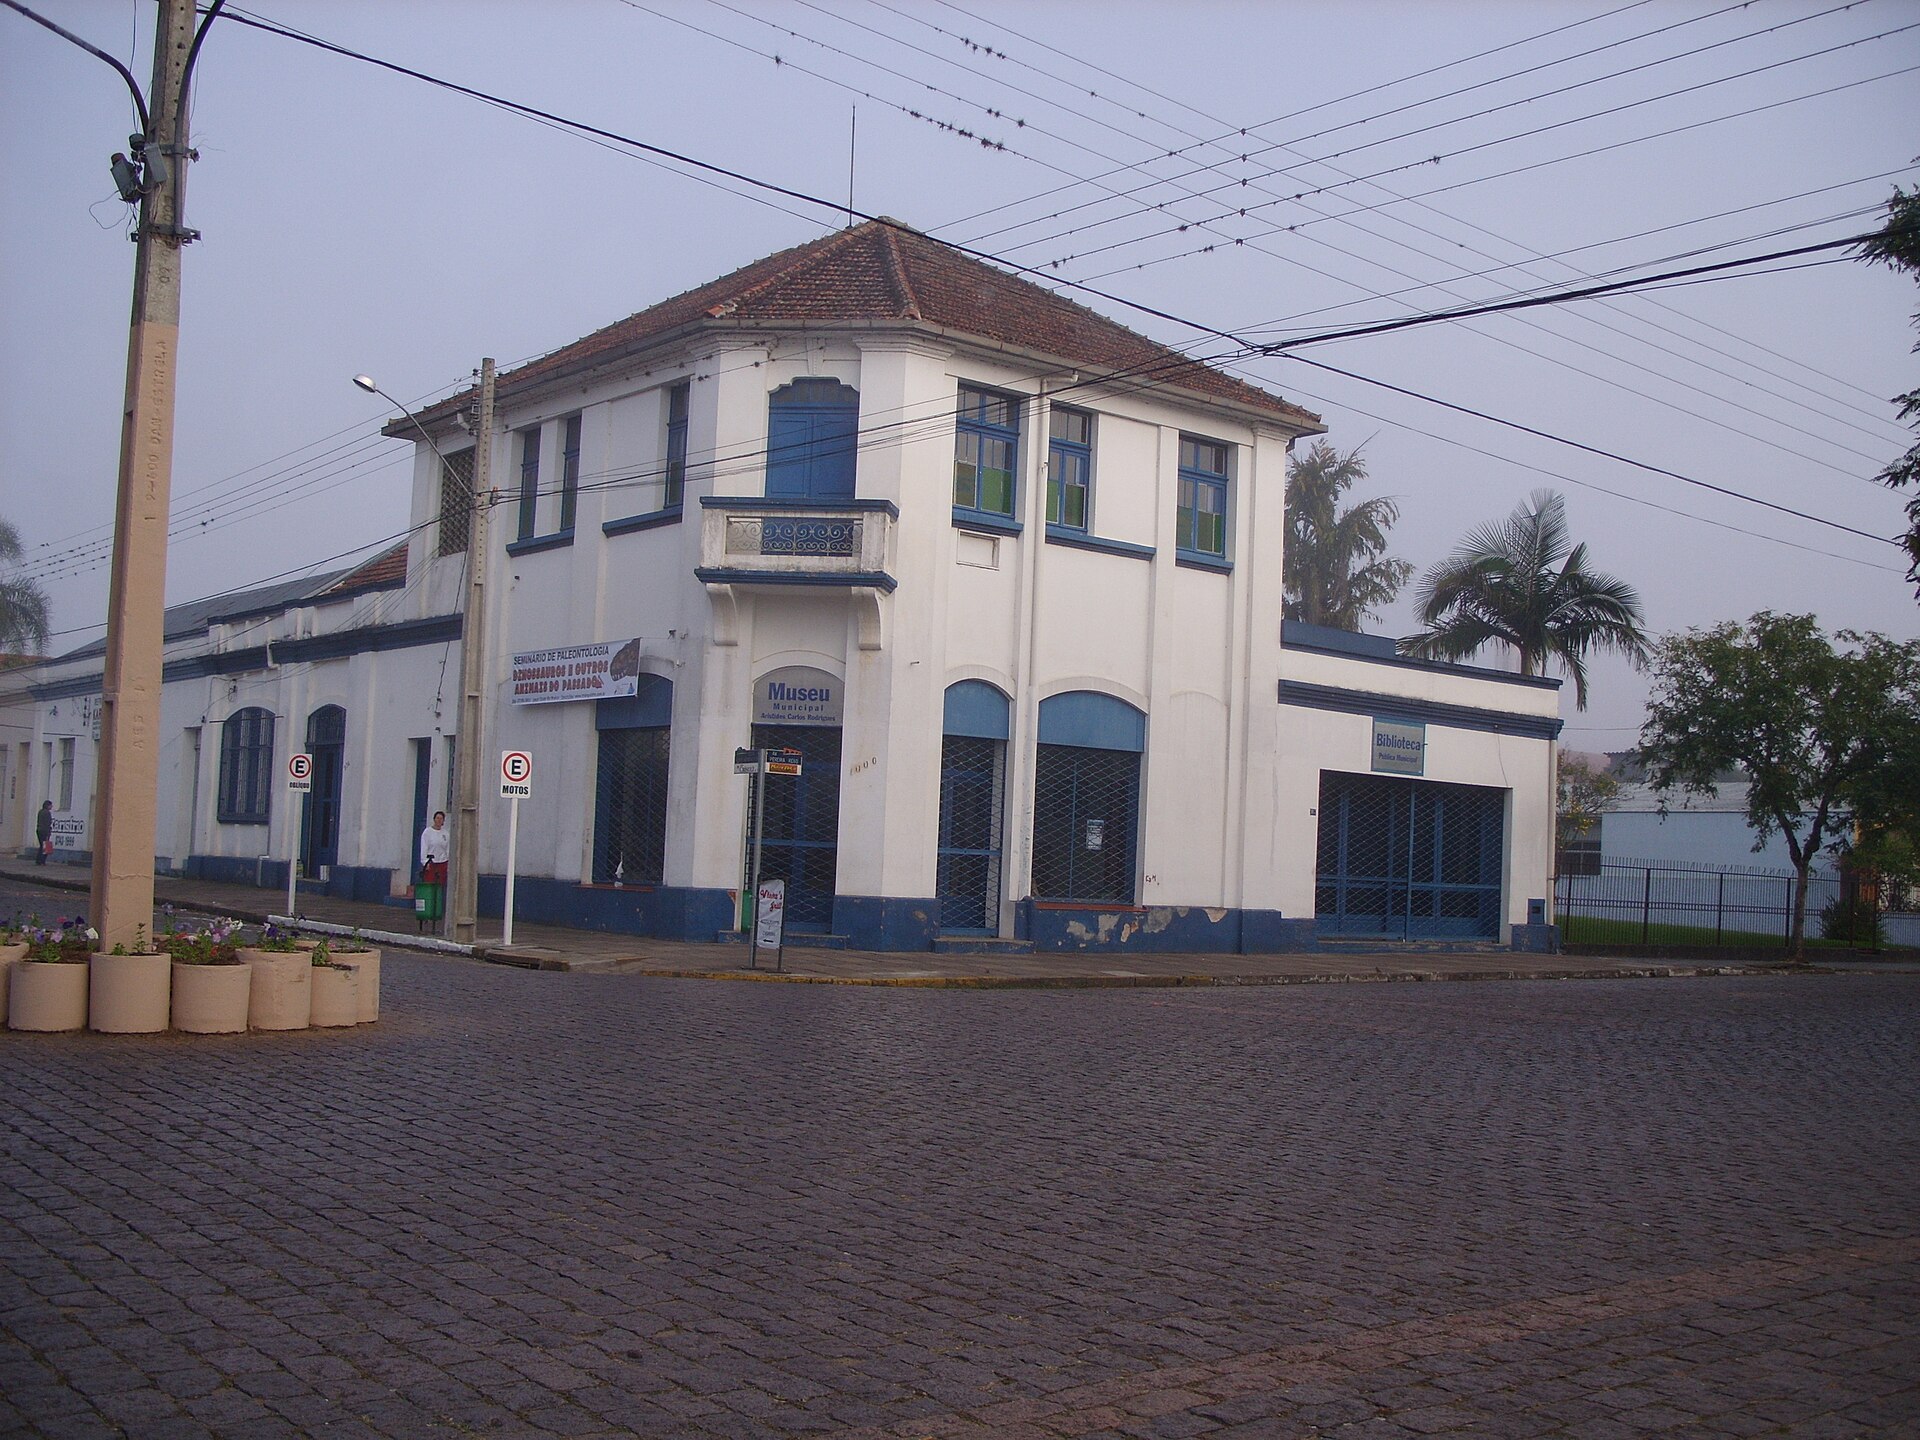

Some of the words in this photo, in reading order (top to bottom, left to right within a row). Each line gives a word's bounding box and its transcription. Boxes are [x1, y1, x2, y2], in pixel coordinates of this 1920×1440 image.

[547, 652, 556, 661] DE
[557, 646, 609, 660] PALEONTOLOGIA
[513, 664, 566, 681] DINOSSAUROS
[568, 664, 573, 676] E
[575, 660, 608, 676] OUTROS
[514, 681, 548, 695] ANIMAIS
[549, 680, 559, 693] DO
[562, 675, 600, 691] PASSADO
[768, 682, 830, 702] Museu
[773, 703, 824, 712] Municipal
[787, 713, 806, 721] Carlos
[1376, 733, 1421, 751] Biblioteca
[1396, 754, 1418, 763] Municipal
[295, 760, 305, 774] E
[511, 759, 522, 775] E
[502, 785, 529, 795] MOTOS
